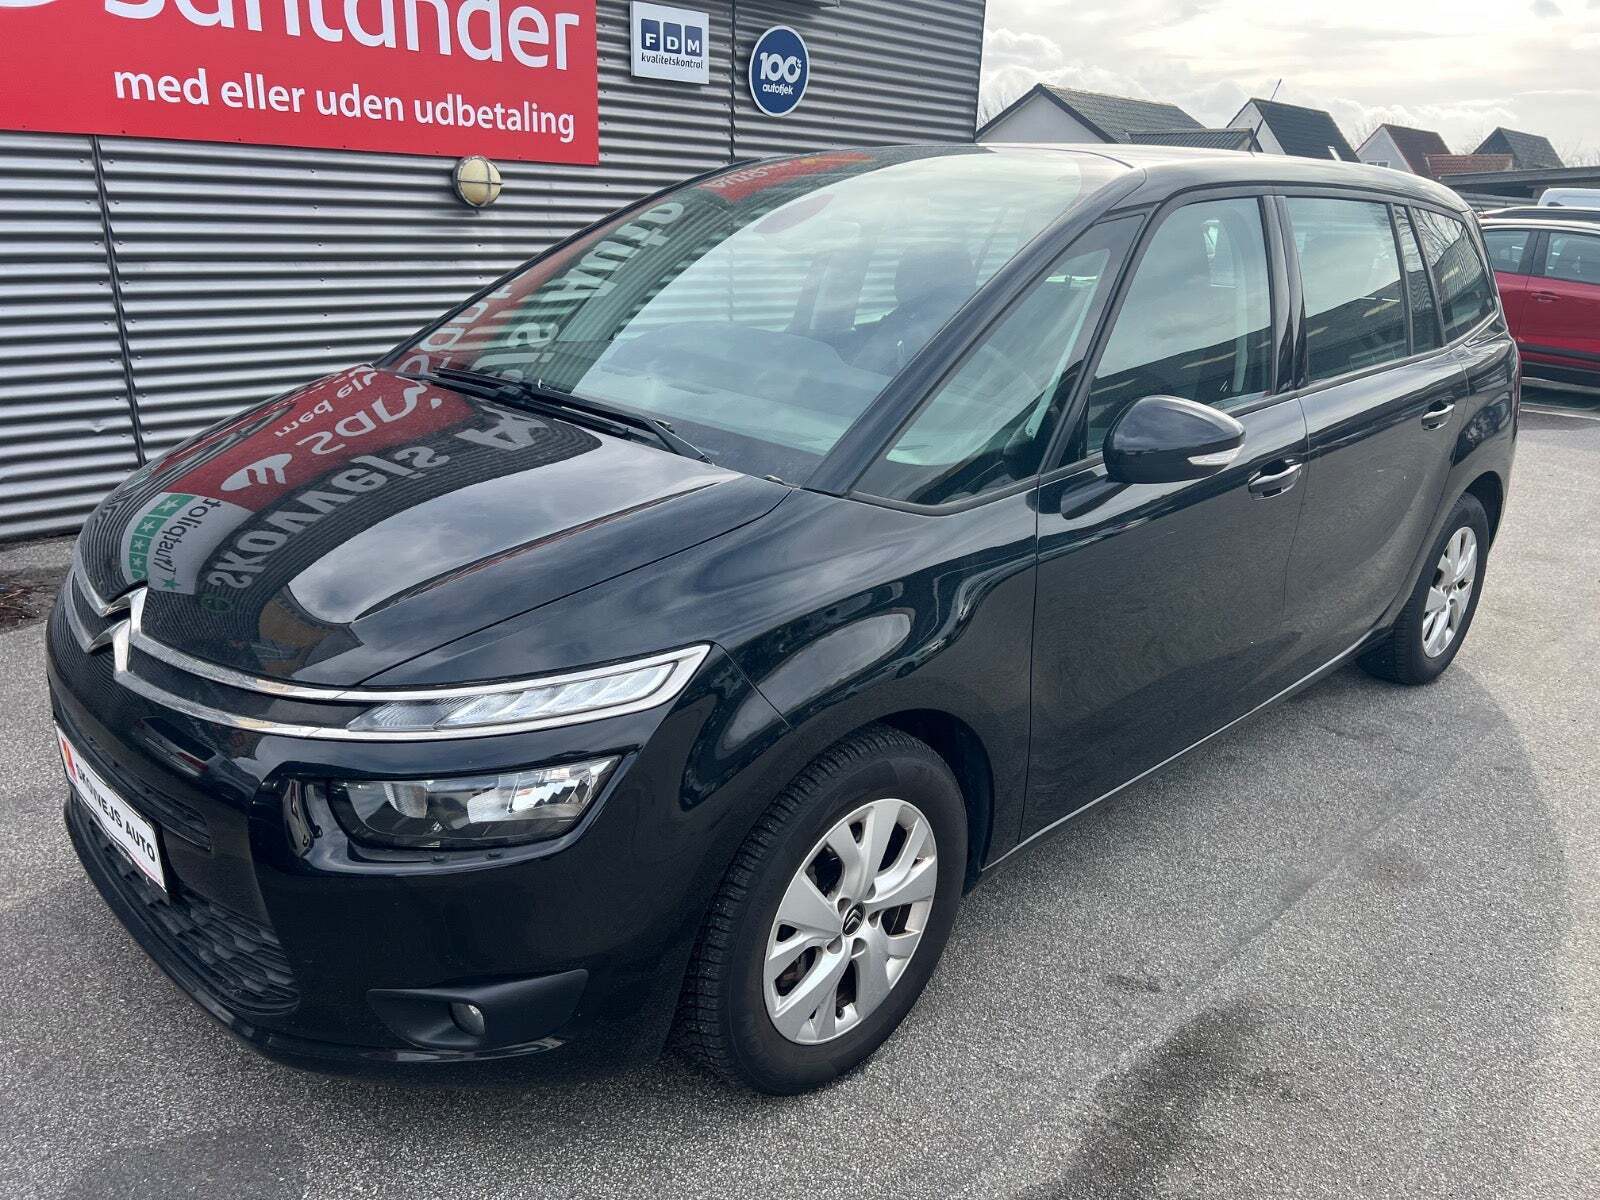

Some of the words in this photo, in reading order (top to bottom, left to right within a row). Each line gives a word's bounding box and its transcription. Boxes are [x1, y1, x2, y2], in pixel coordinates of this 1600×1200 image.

[645, 33, 701, 53] FDM
[641, 52, 703, 69] kvalitetskontrol
[112, 67, 210, 106] med
[220, 73, 306, 113] eller
[315, 83, 405, 122] uden
[413, 94, 576, 144] udbetaling
[125, 820, 156, 863] AUTO
